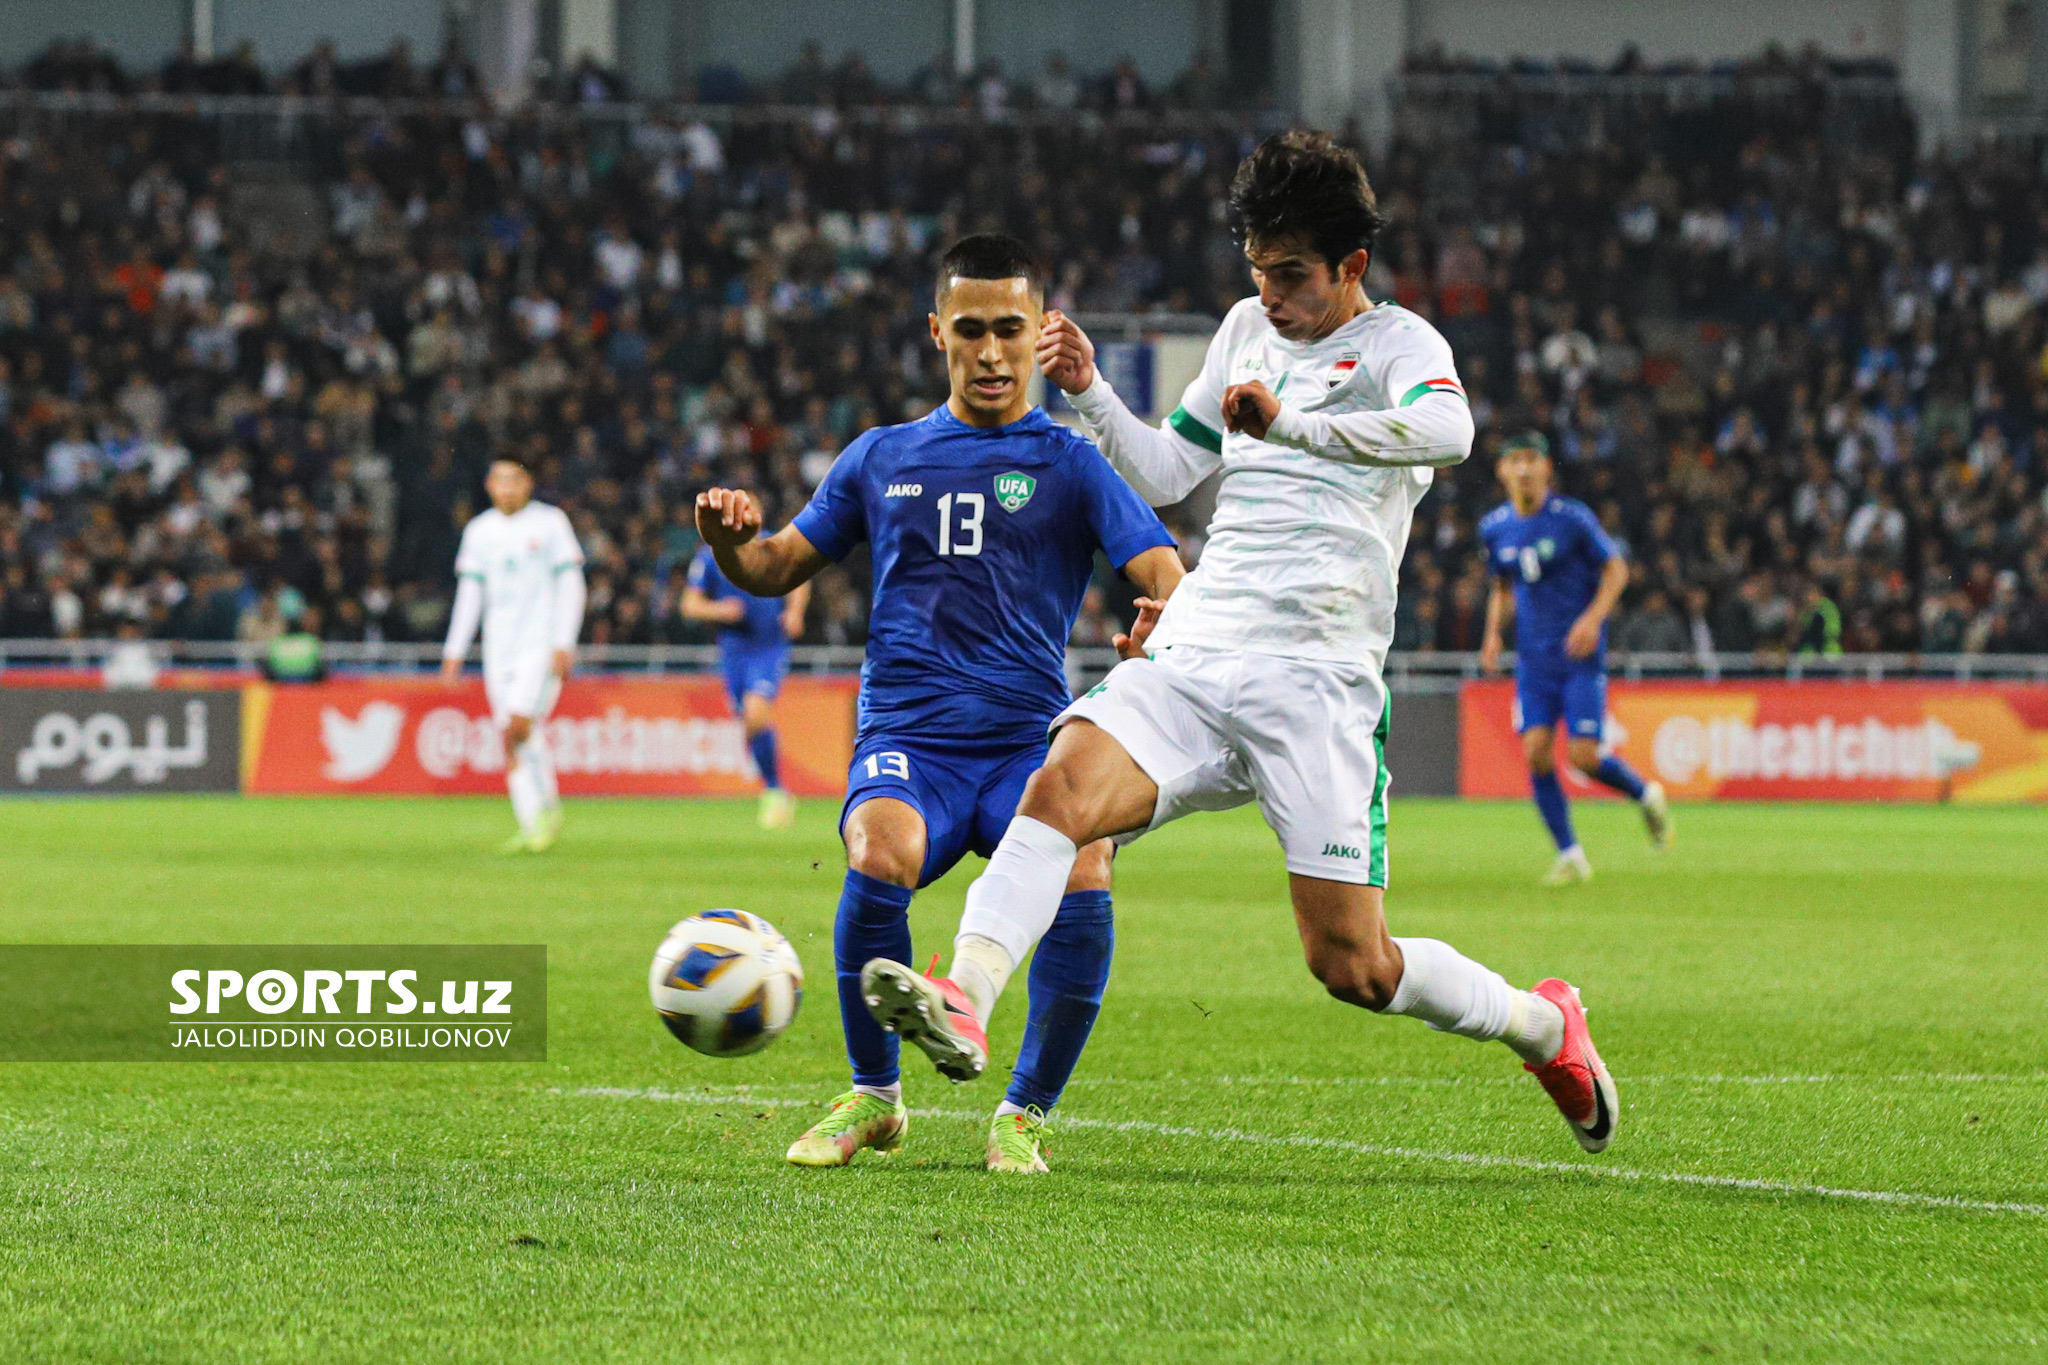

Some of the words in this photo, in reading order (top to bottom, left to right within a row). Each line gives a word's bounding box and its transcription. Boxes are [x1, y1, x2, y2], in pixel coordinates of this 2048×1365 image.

[885, 484, 923, 497] JAKO
[999, 479, 1028, 496] UFA
[937, 492, 985, 556] 13
[863, 751, 909, 781] 13
[1321, 843, 1361, 860] JAKO
